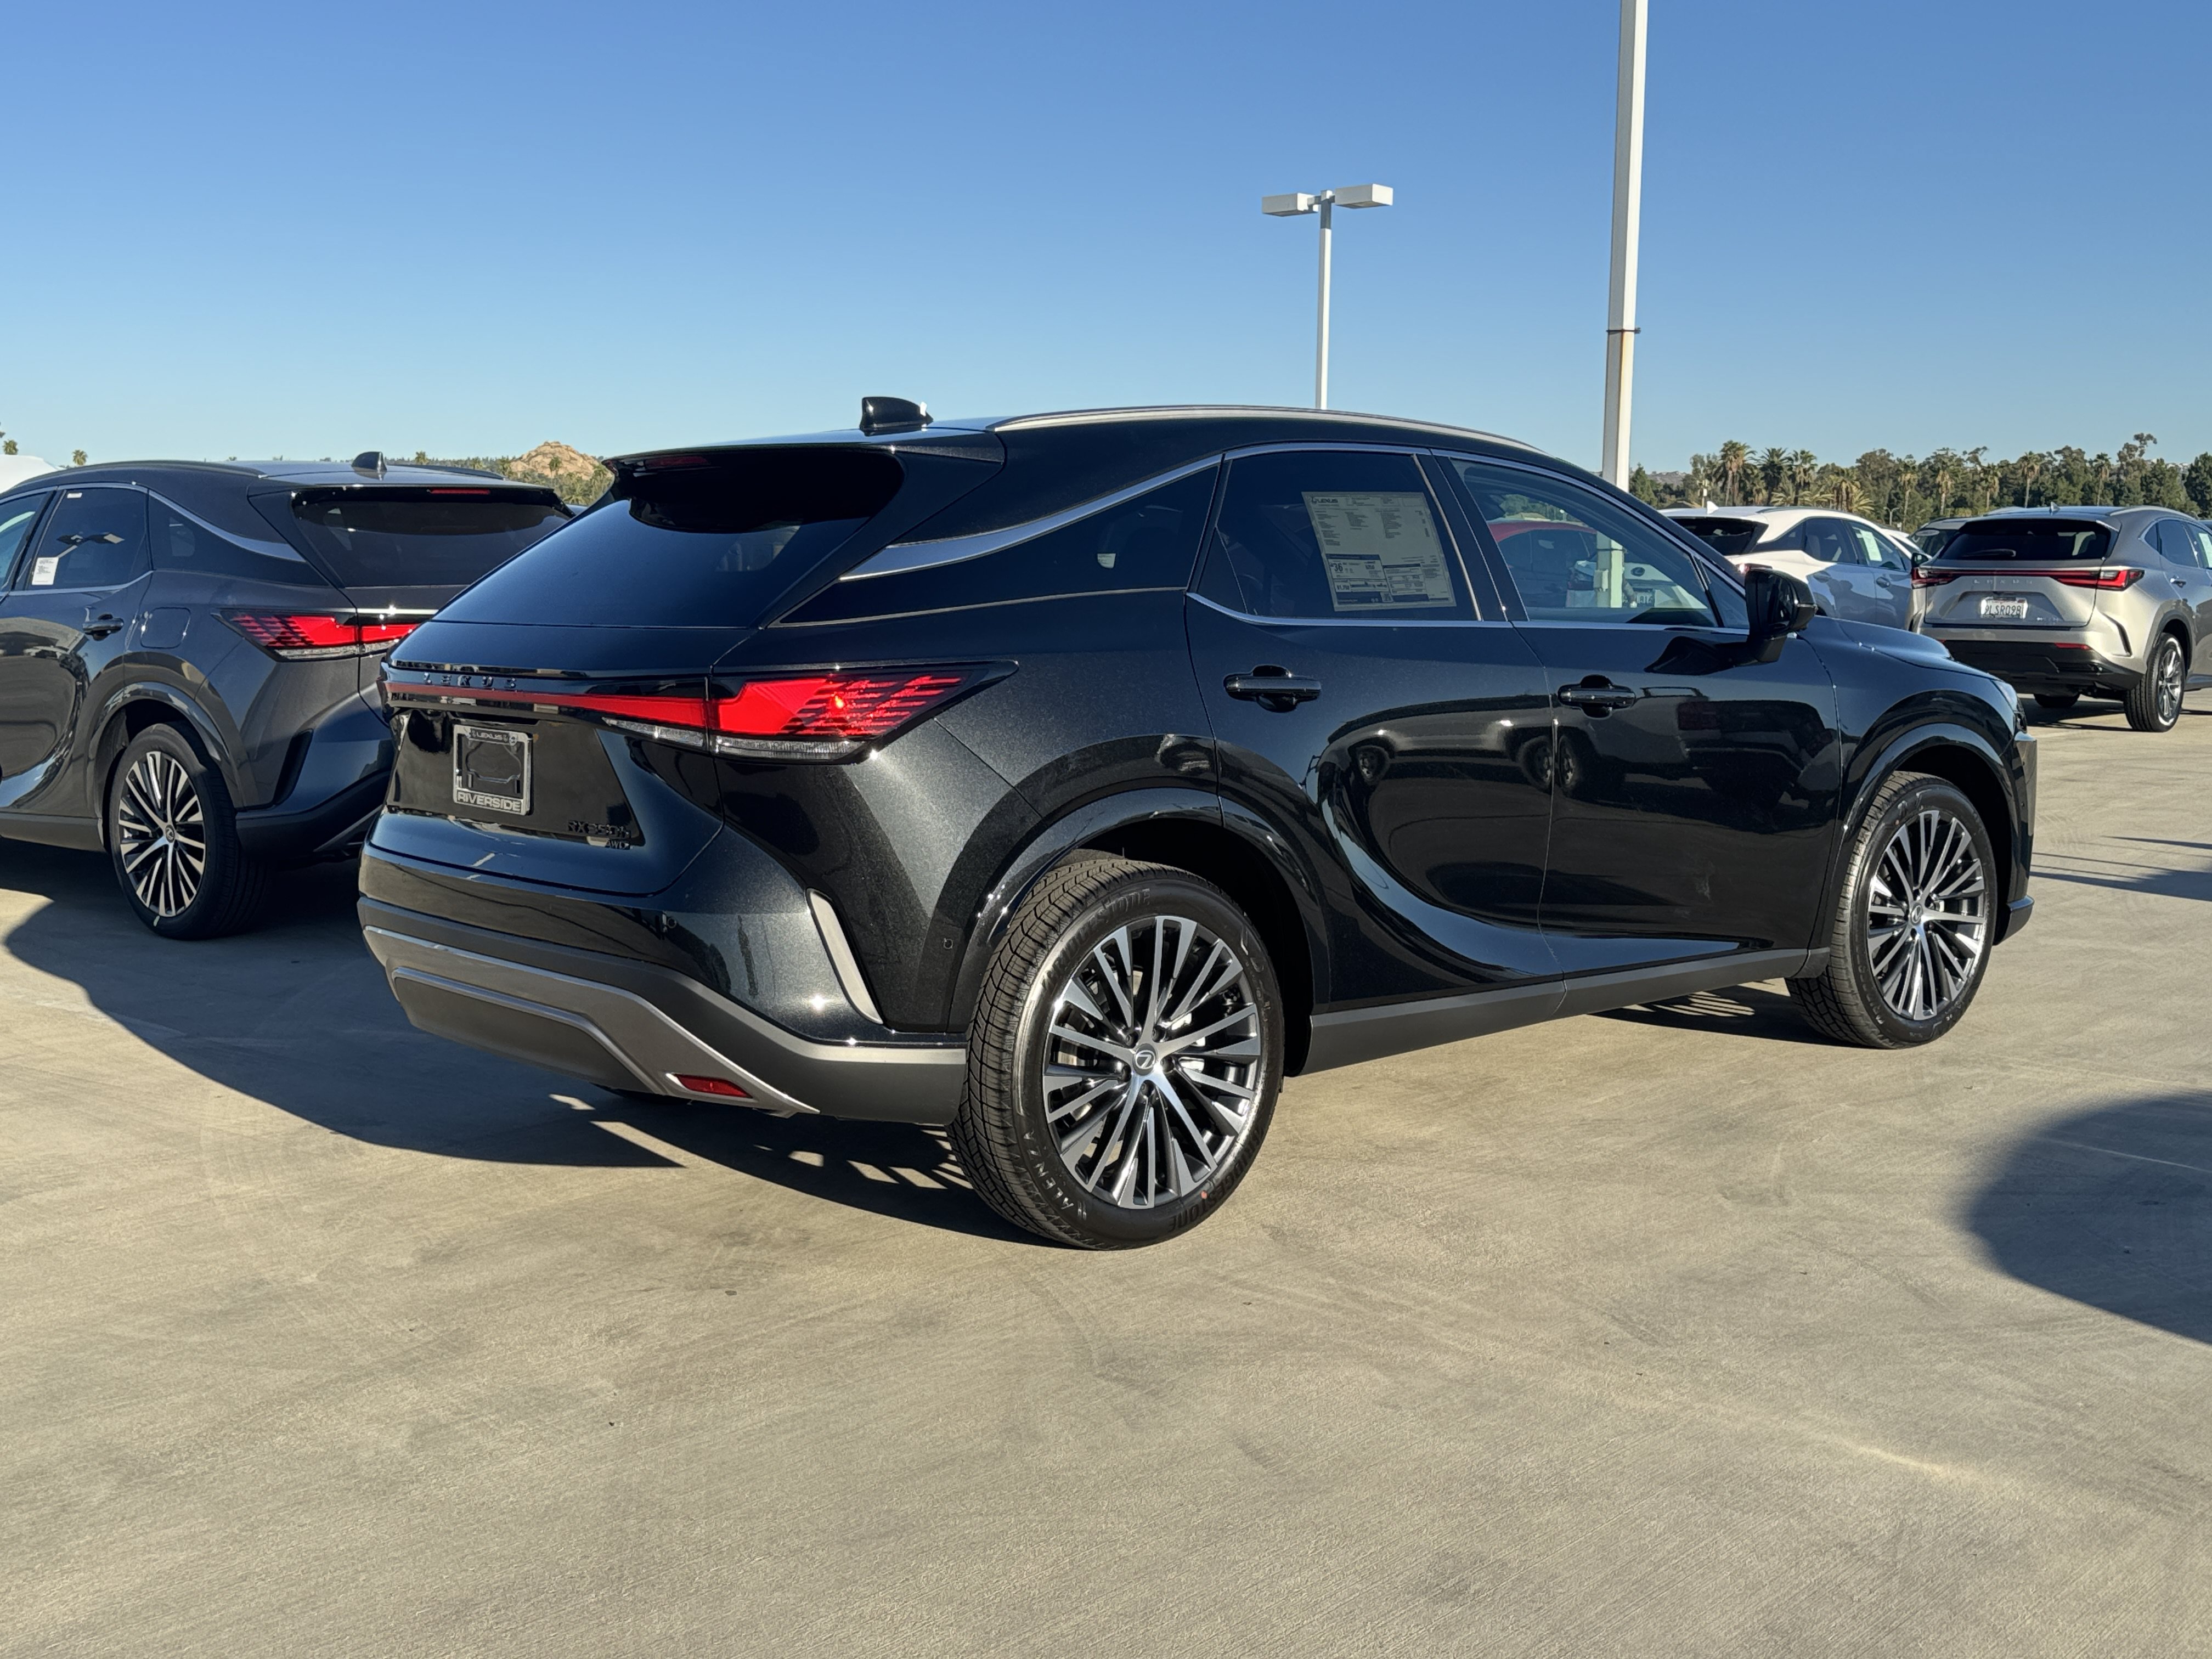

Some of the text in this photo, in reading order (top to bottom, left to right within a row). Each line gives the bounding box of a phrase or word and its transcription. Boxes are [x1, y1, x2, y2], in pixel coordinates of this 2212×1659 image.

[1333, 563, 1343, 572] 36
[1985, 605, 2022, 617] 9LSR098
[424, 672, 517, 689] LEXUS
[477, 731, 503, 740] LEXUS
[458, 792, 521, 811] RIVERSIDE
[606, 838, 630, 850] AWD
[1023, 1129, 1075, 1210] ALENZA
